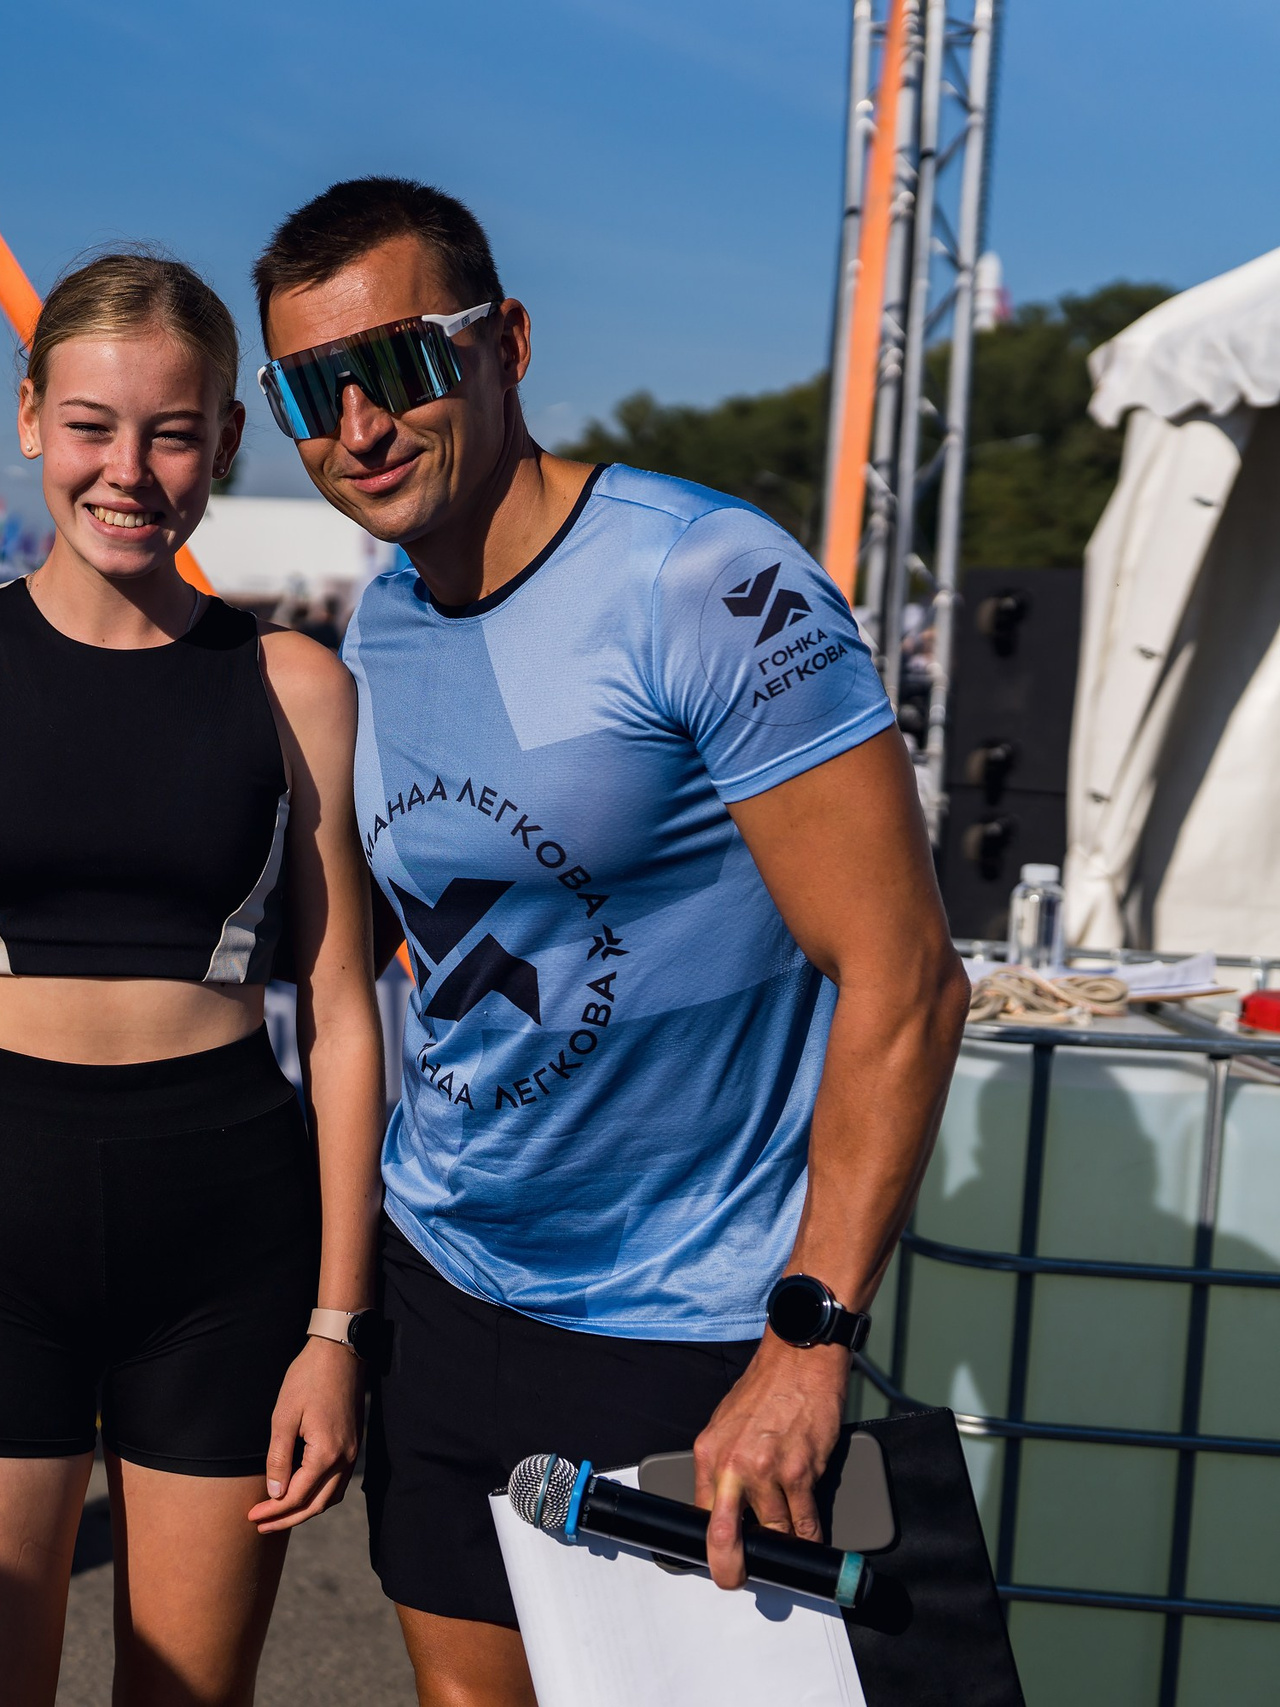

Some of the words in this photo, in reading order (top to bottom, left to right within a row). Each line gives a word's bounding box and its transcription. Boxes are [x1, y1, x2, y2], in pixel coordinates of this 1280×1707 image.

[752, 641, 848, 709] ЛЕГКОВА
[757, 628, 828, 676] ГОНКА
[456, 777, 611, 919] ЛЕГКОВА
[495, 971, 617, 1110] ЛЕГКОВА
